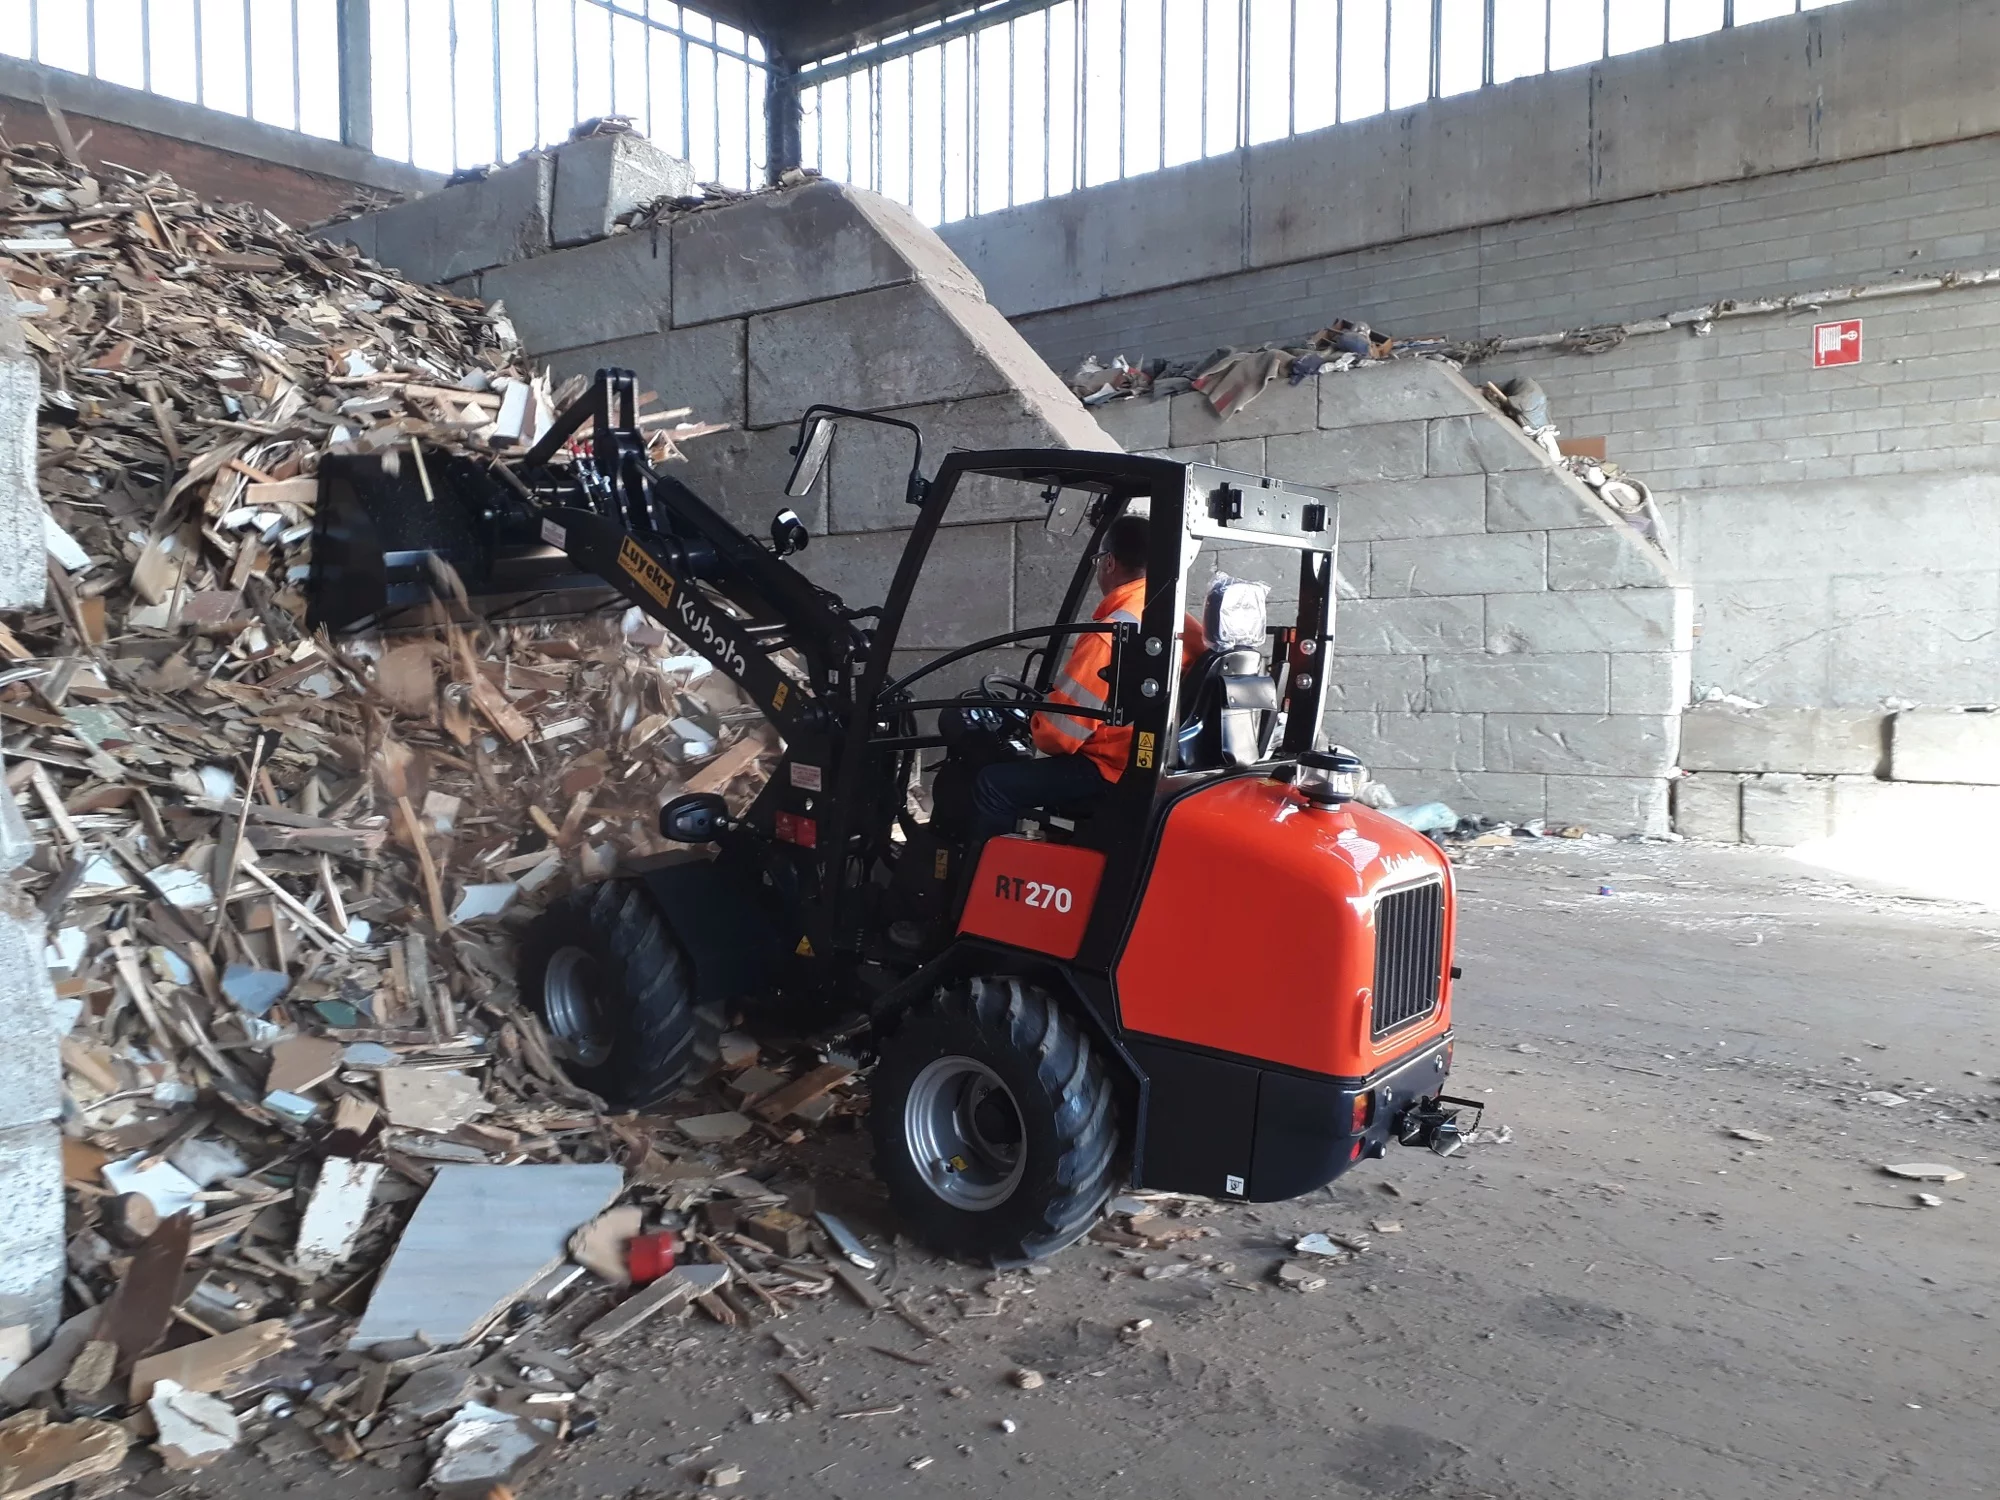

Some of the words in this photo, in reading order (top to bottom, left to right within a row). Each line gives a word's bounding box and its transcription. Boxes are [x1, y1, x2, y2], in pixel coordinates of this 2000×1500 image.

[622, 538, 672, 596] Luyckx
[677, 592, 746, 677] Kubota
[995, 874, 1072, 913] RT270
